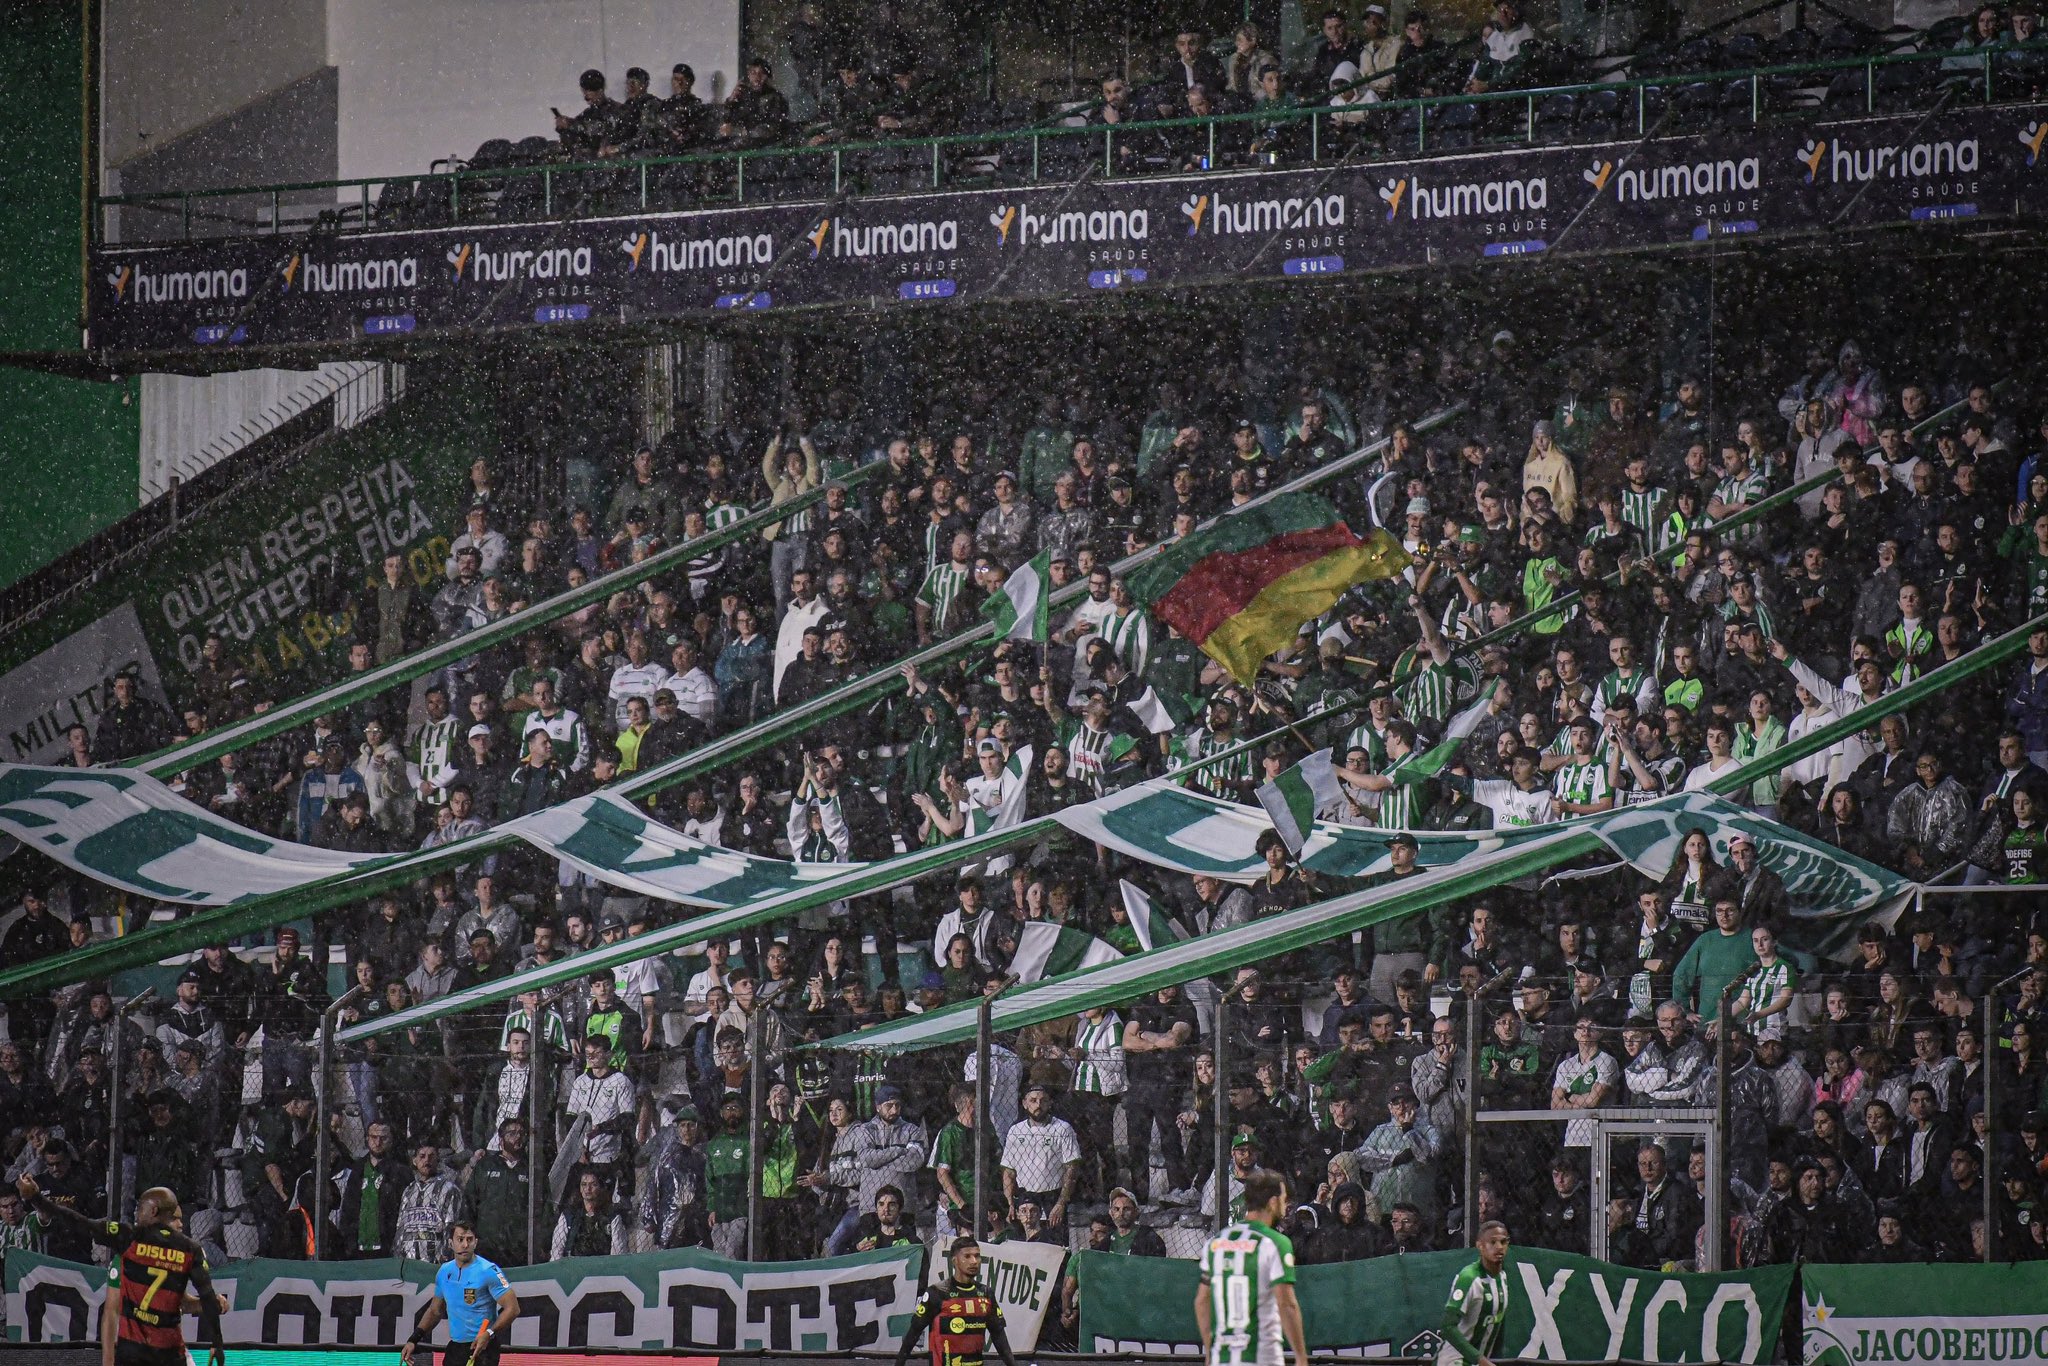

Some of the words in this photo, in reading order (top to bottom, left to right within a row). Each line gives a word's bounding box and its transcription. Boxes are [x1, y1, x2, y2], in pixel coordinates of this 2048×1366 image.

[1618, 158, 1759, 202] humana
[1832, 138, 1978, 183] humana
[1412, 177, 1546, 219] humana
[1695, 199, 1759, 216] SAÚDE
[1913, 182, 1978, 198] SAÚDE
[1020, 204, 1147, 245] humana
[1213, 193, 1344, 234] humana
[1485, 219, 1546, 235] SAÚDE
[652, 231, 773, 271] humana
[835, 217, 957, 257] humana
[304, 253, 417, 293] humana
[474, 242, 591, 282] humana
[1104, 274, 1123, 285] SU
[134, 264, 247, 303] humana
[209, 328, 225, 340] SU
[162, 548, 259, 629] QUEM
[260, 457, 416, 571] RESPEITA
[178, 633, 208, 673] O
[204, 546, 358, 641] UTEB
[356, 498, 433, 566] FICA
[2009, 860, 2027, 878] 25
[136, 1243, 185, 1264] DISLUB
[147, 1266, 168, 1311] 7
[938, 1249, 1049, 1312] JNTUDE
[1212, 1275, 1251, 1330] 10
[1516, 1261, 1762, 1362] XYCO
